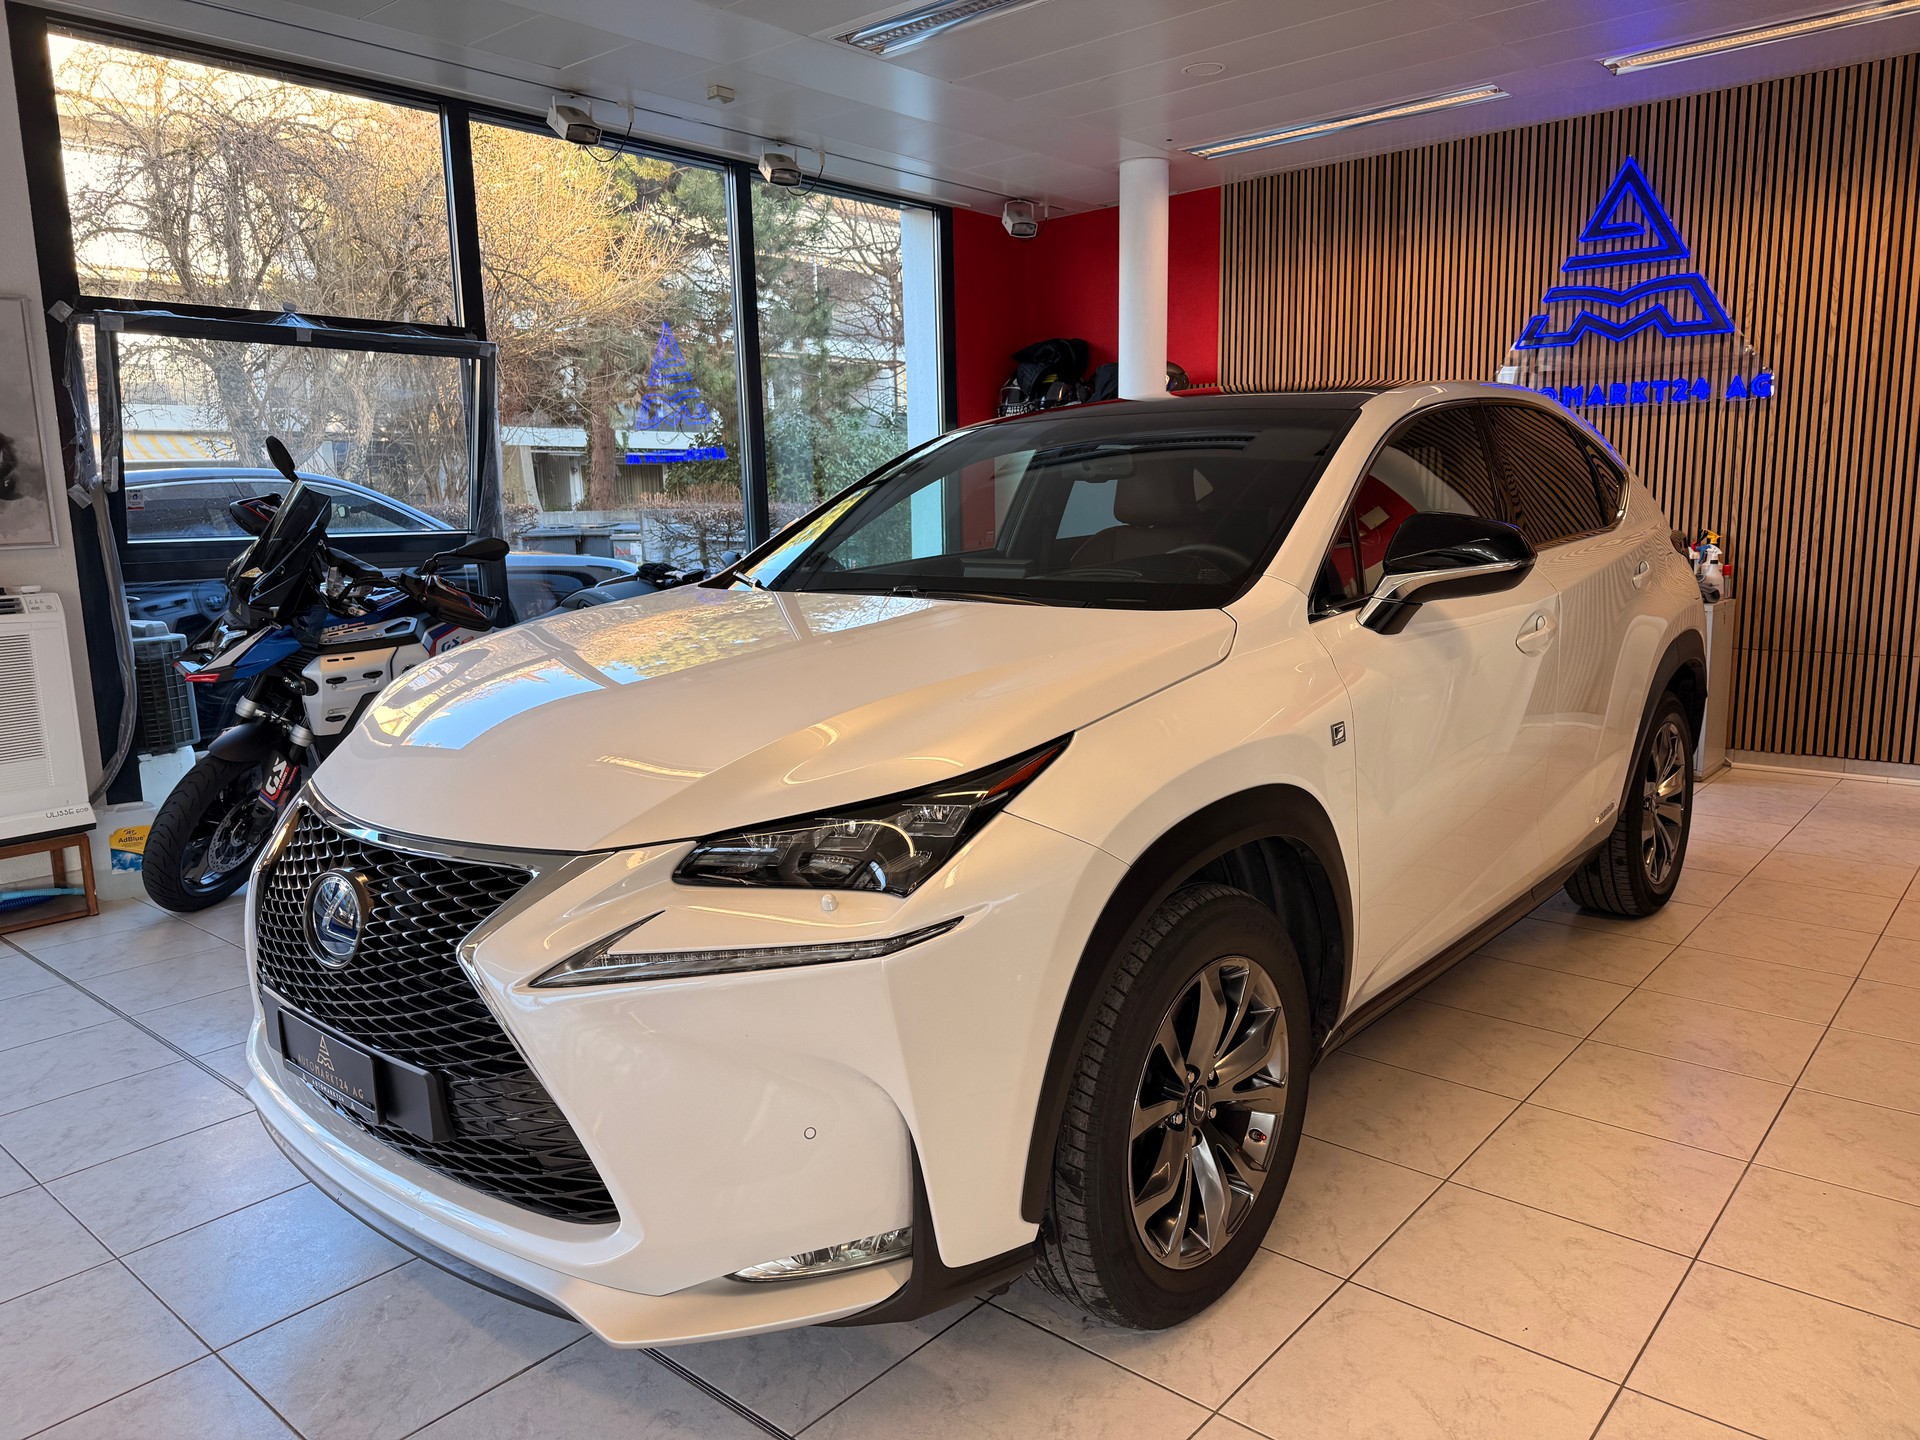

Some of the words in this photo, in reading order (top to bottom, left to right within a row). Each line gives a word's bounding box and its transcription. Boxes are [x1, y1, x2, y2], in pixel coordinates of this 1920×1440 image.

[1725, 372, 1774, 399] AG
[265, 756, 288, 796] GS
[297, 1053, 349, 1093] AUTOMARKT24
[352, 1085, 364, 1100] AG
